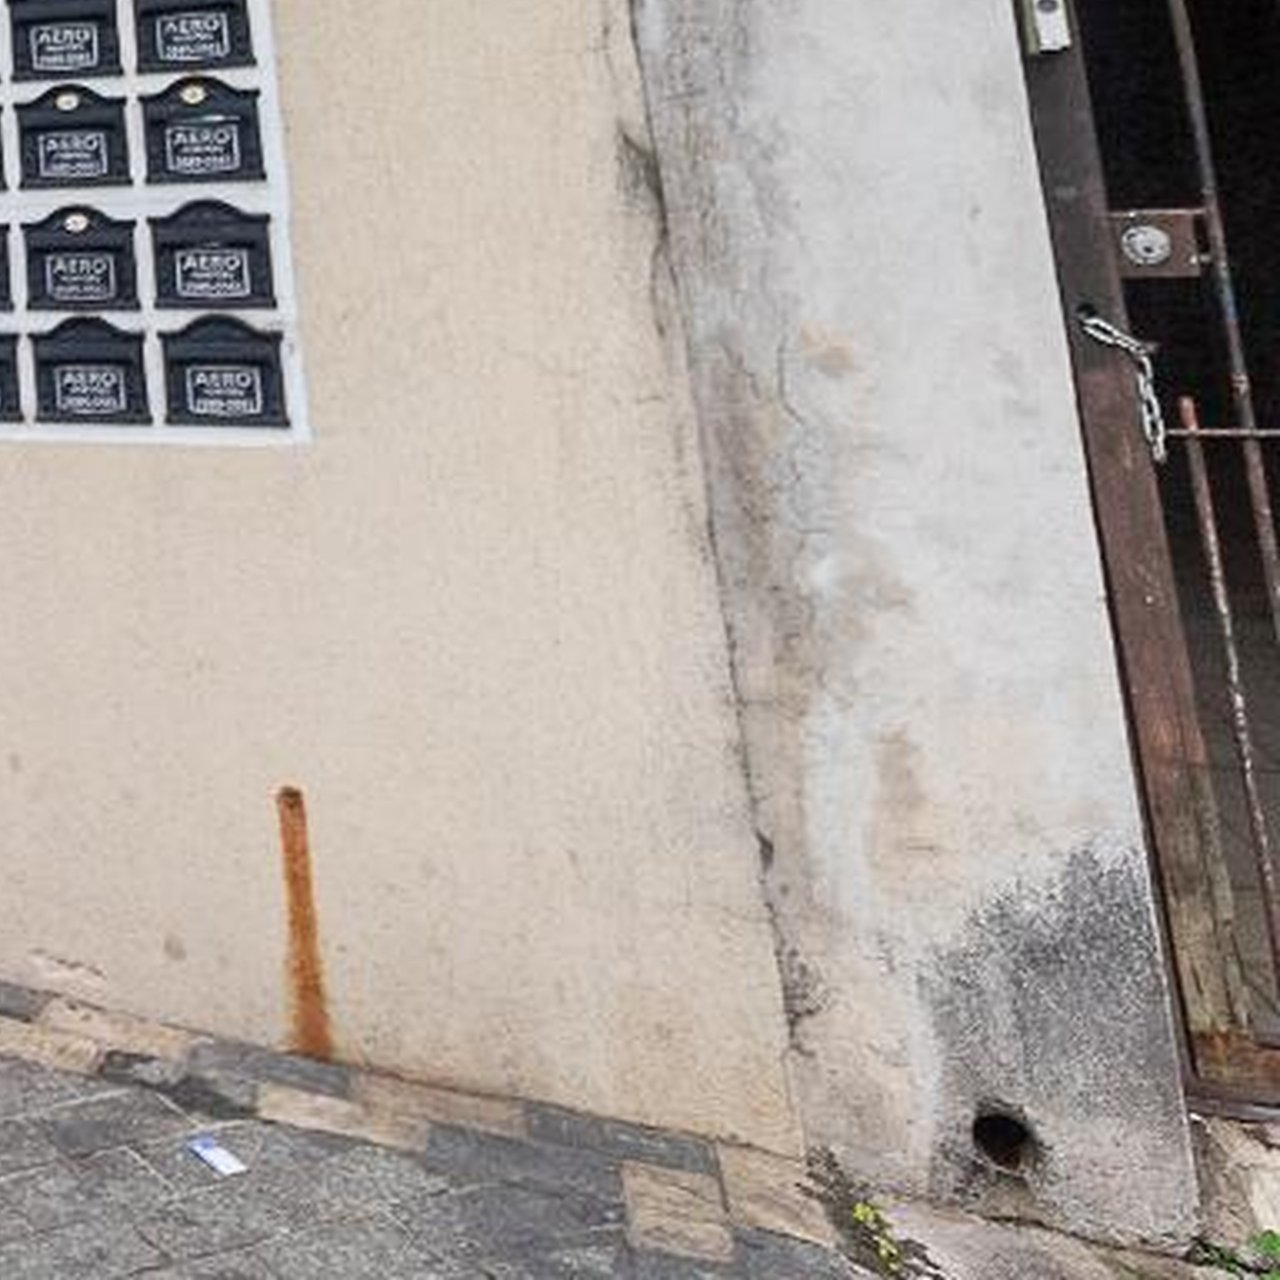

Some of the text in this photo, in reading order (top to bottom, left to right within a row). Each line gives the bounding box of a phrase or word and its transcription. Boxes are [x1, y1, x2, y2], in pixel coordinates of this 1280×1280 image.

[38, 26, 90, 45] AERO
[164, 18, 220, 37] AERO
[53, 256, 106, 274] AERO
[182, 252, 241, 272] AERO
[195, 369, 251, 388] AERO
